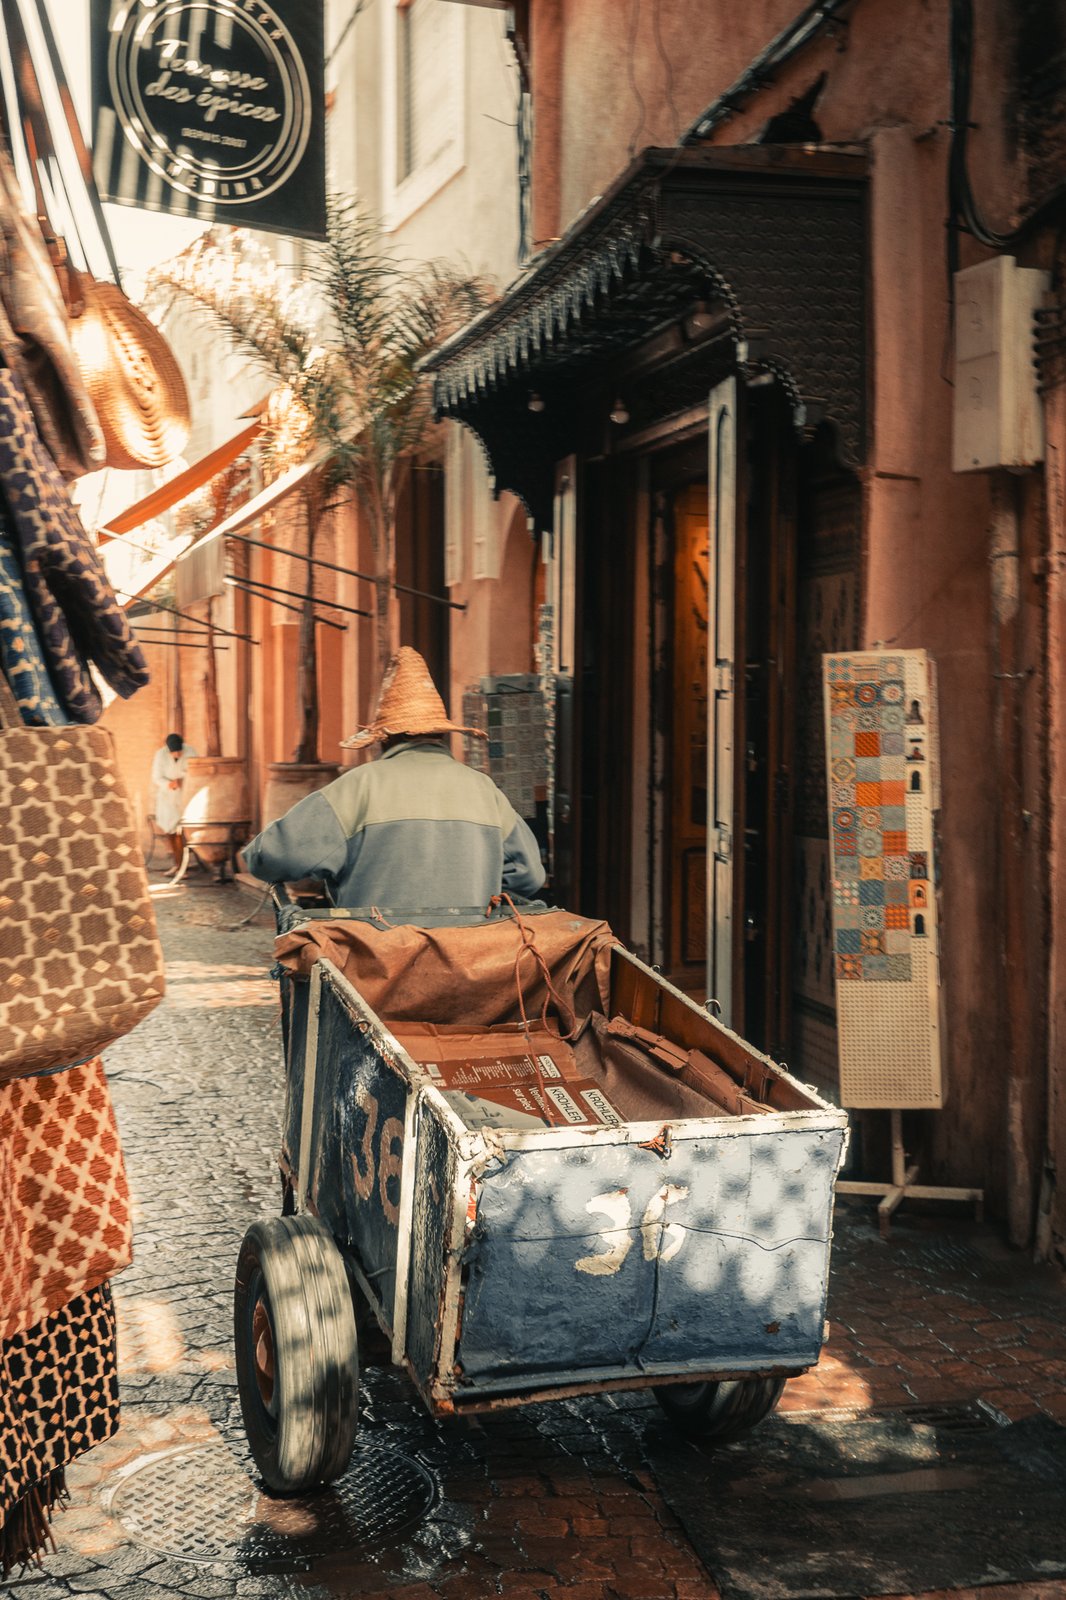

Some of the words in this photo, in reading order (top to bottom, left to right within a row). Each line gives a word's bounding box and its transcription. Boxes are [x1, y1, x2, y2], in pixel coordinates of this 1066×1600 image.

[145, 71, 195, 102] des
[550, 1088, 582, 1121] KROHLER
[574, 1183, 690, 1276] 36
